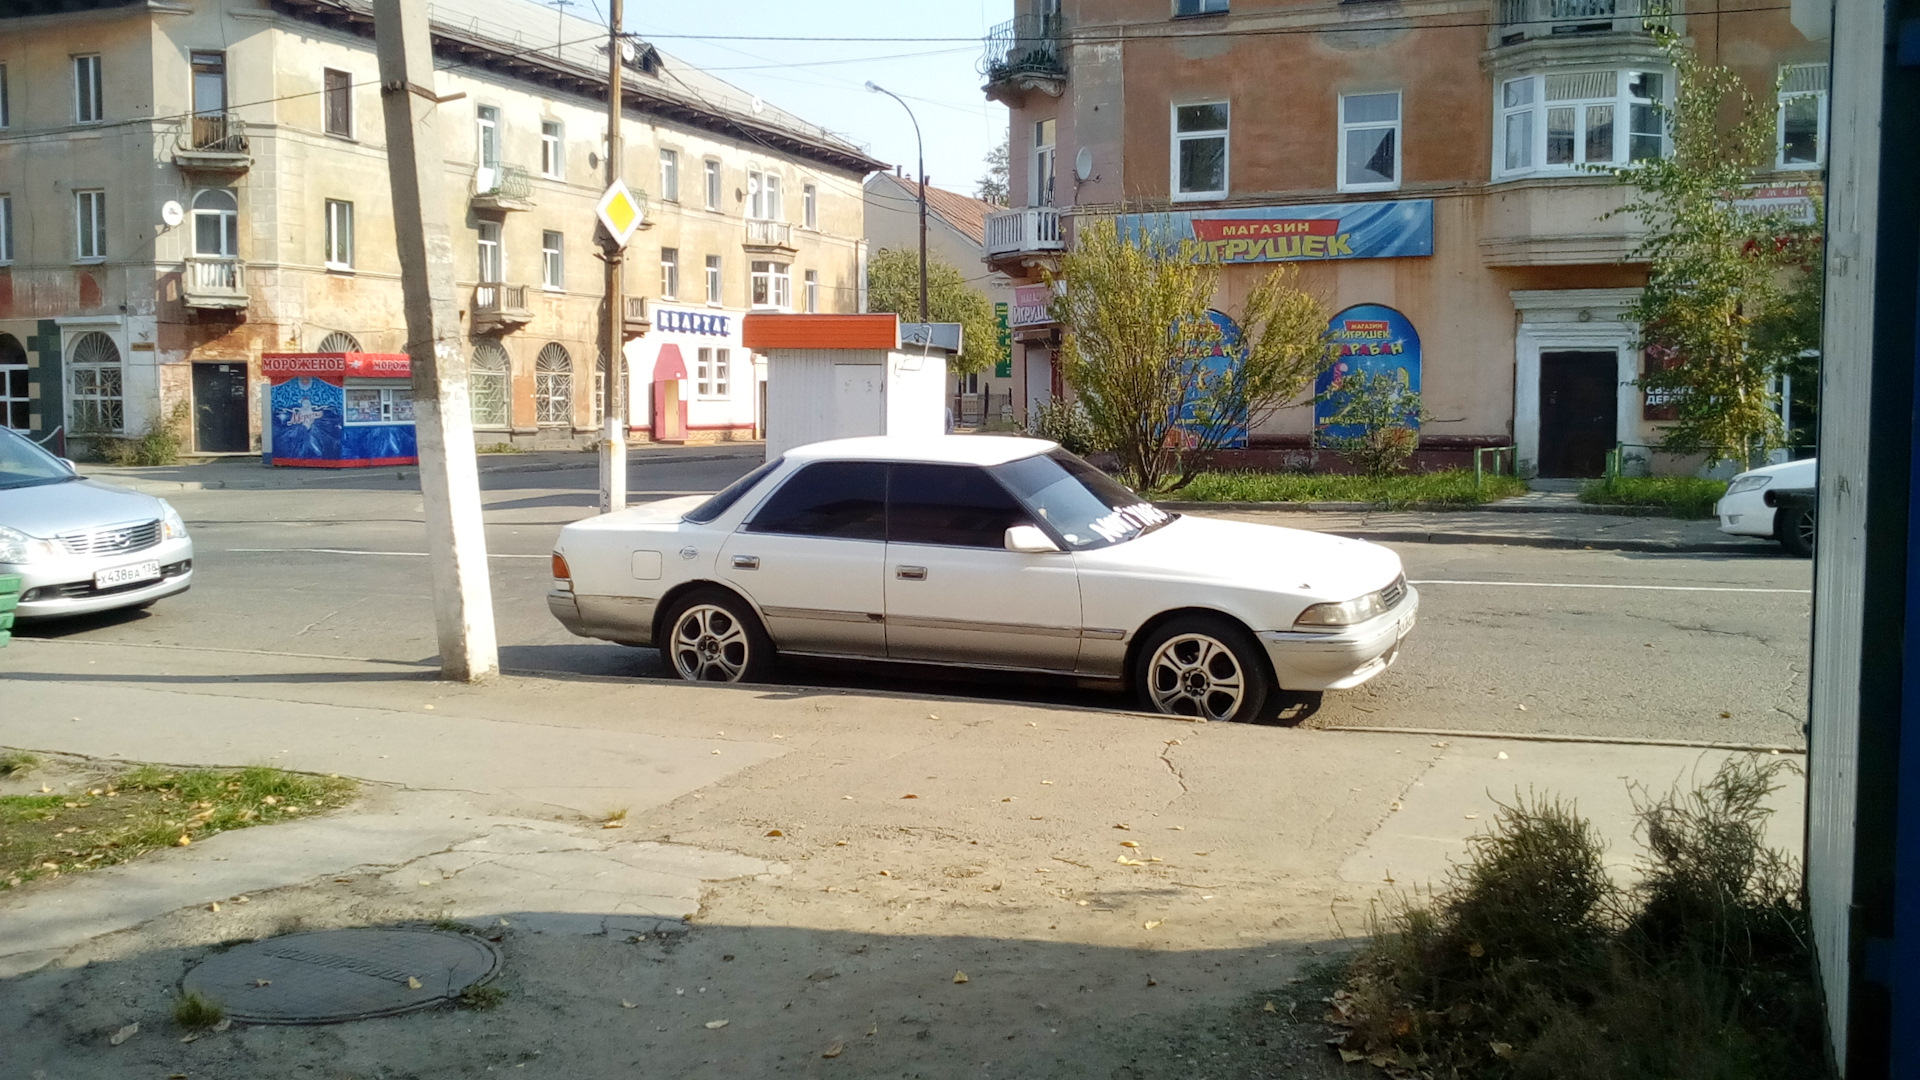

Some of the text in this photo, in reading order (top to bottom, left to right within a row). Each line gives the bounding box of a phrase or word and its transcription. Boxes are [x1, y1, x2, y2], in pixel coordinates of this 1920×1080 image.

[1222, 222, 1310, 236] МАГАЗИН
[1189, 233, 1353, 263] ИГРУШЕК
[1013, 303, 1056, 325] ИГРУШ
[657, 309, 731, 337] КВАРТАЛ
[1341, 330, 1390, 339] ИГРУШЕК
[1337, 341, 1404, 356] АРАБАН
[262, 357, 345, 371] МОРОЖЕНОЕ
[373, 359, 411, 371] МОРОЖ
[142, 563, 157, 573] 138
